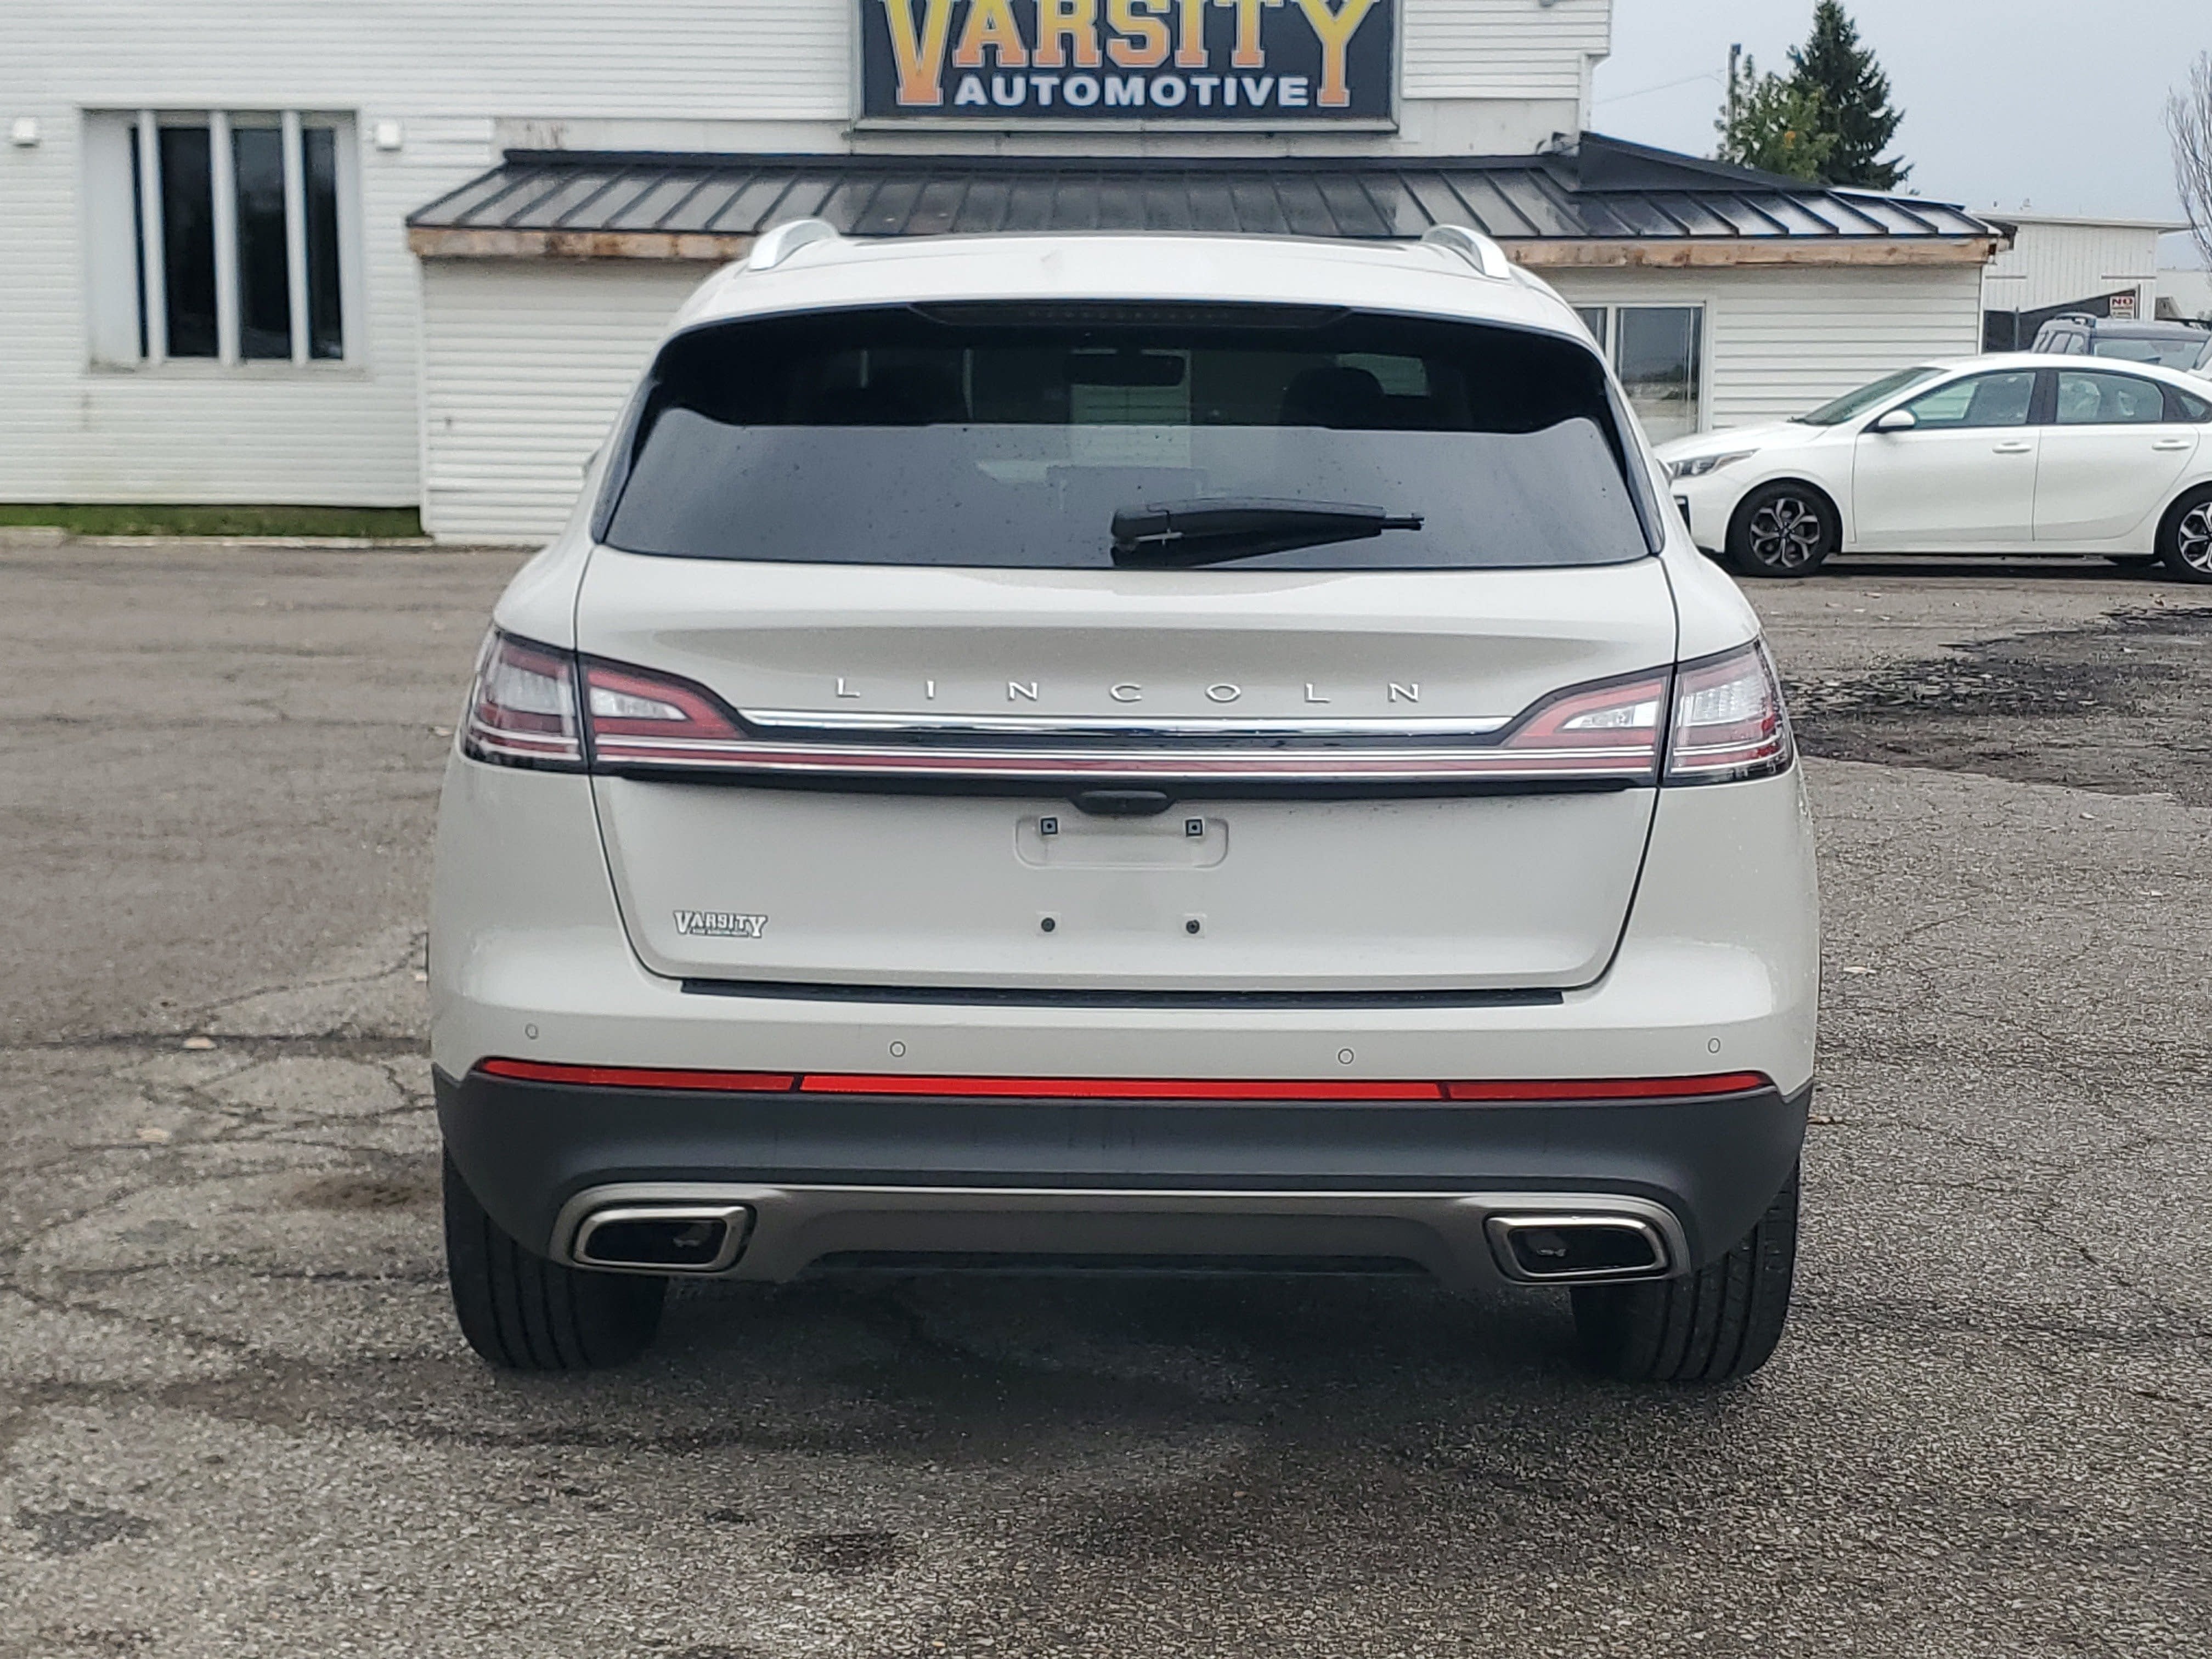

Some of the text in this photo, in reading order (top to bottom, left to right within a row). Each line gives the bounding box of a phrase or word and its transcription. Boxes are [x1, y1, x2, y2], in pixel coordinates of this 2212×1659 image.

[884, 0, 1381, 107] VARSITY
[953, 75, 1310, 107] AUTOMOTIVE
[834, 677, 1421, 703] LINCOLN
[674, 911, 767, 938] VARSITY
